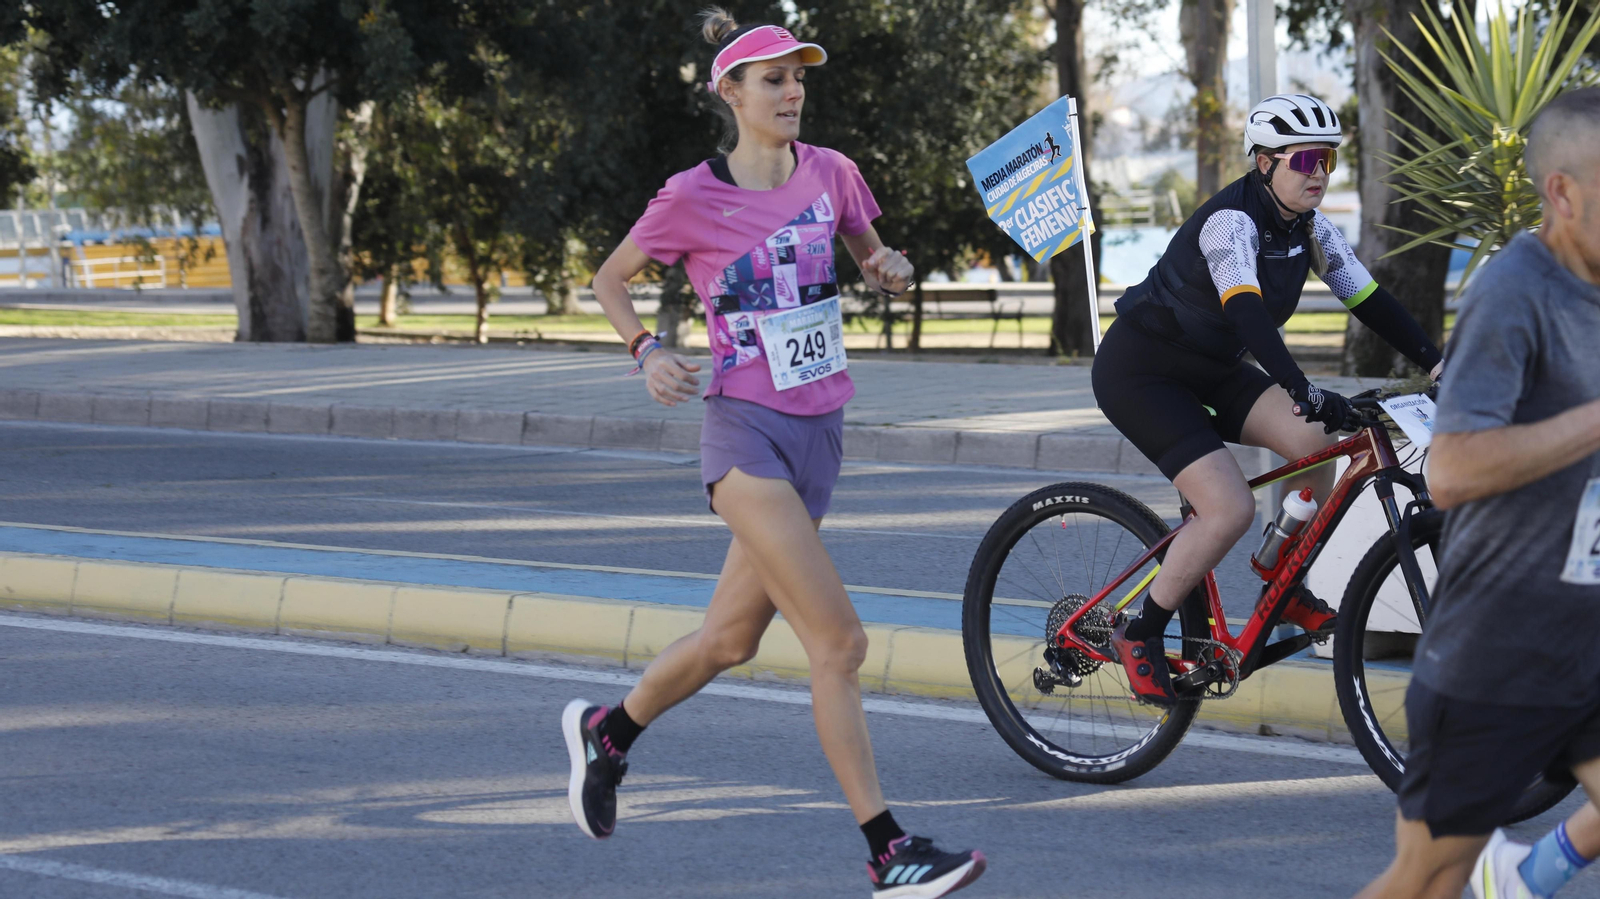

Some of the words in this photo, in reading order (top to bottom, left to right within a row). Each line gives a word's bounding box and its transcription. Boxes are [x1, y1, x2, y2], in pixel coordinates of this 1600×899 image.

[981, 167, 1008, 192] MEDIA
[1005, 142, 1044, 176] MARATÓN
[987, 181, 1010, 203] CIUDAD
[1008, 175, 1018, 189] DE
[1015, 155, 1049, 182] ALGECIRAS
[1014, 178, 1076, 230] CLASIFIC
[807, 243, 826, 255] NIKE
[775, 276, 786, 297] NIKE
[786, 331, 826, 368] 249
[798, 363, 832, 381] EVOS
[1390, 399, 1428, 410] ORGANIZACIÓN
[1032, 495, 1090, 511] MAXXIS
[1256, 493, 1346, 621] ROCKRIDER
